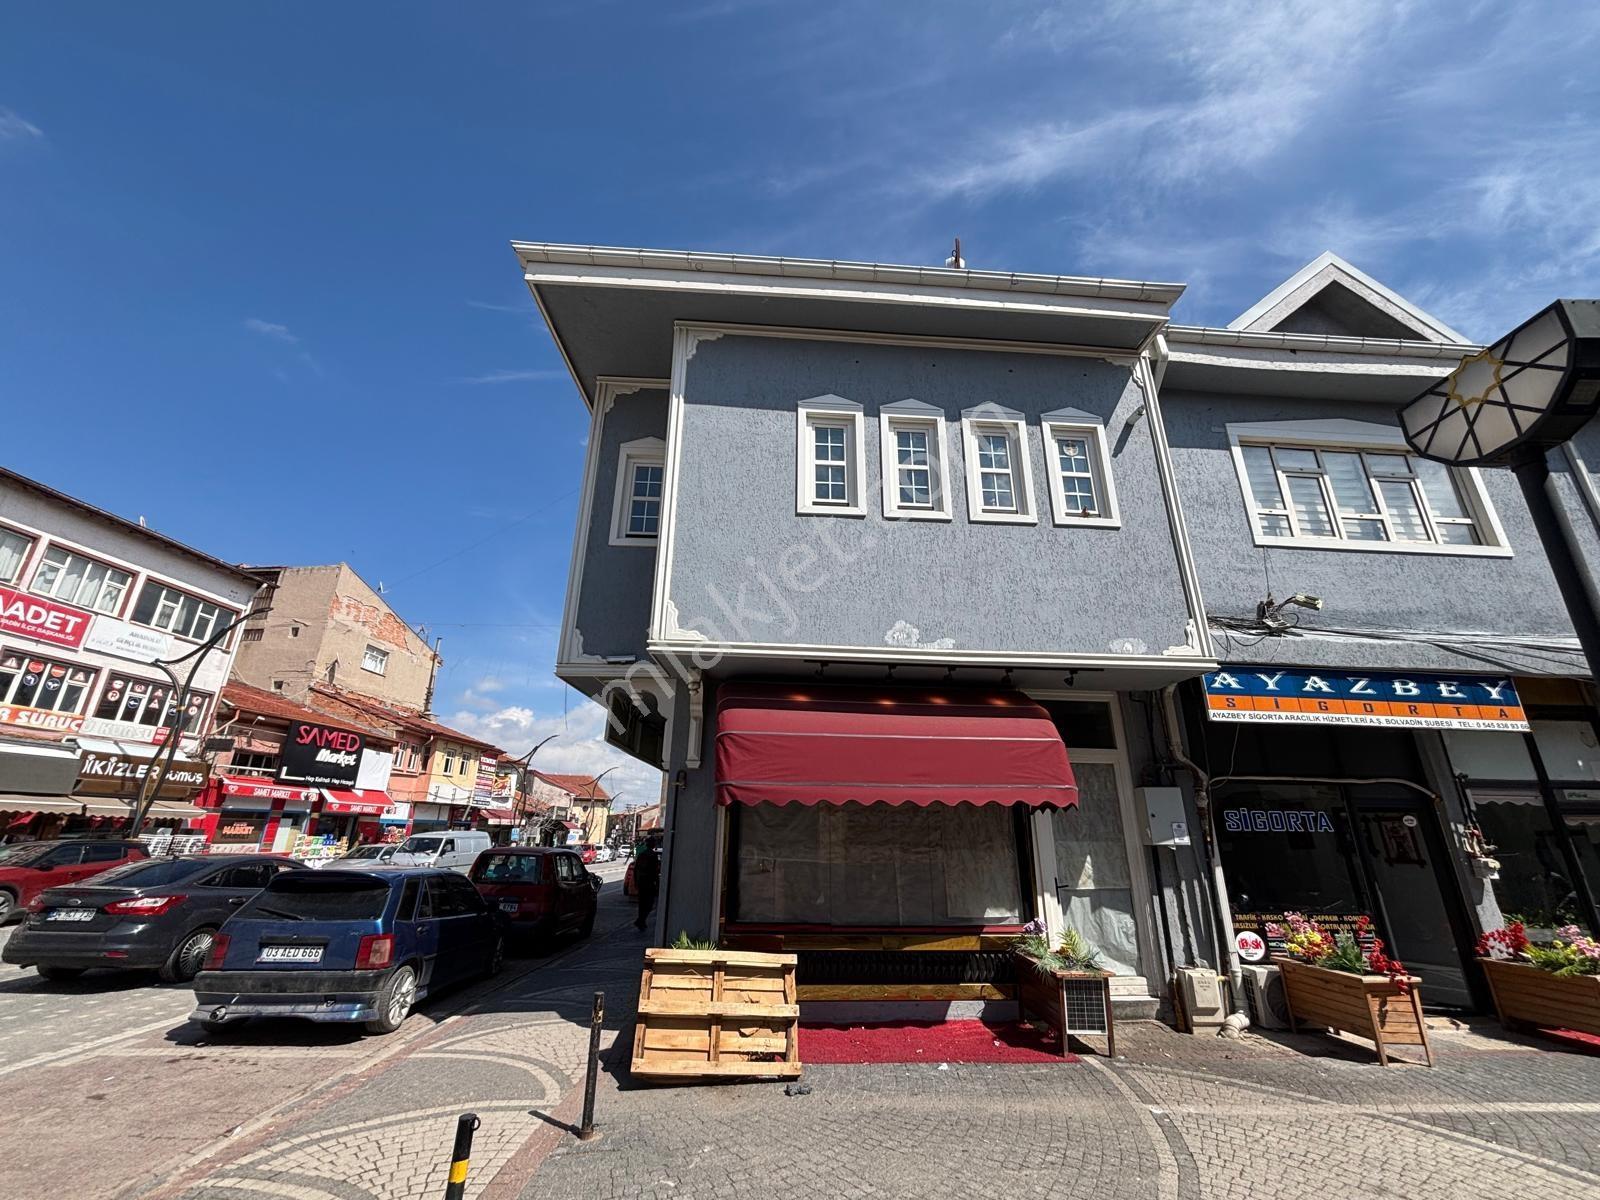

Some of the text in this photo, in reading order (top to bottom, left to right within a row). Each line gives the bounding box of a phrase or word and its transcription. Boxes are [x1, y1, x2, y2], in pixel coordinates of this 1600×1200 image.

[0, 594, 82, 633] ADET
[1210, 670, 1508, 700] AYAZBEY
[1212, 712, 1247, 720] AYAZBEY
[1248, 712, 1284, 721] SİGORTA
[1284, 714, 1321, 722] ARACILIK
[1322, 715, 1368, 724] HİZMETLERİ
[1385, 718, 1423, 726] BOLVADİN
[295, 725, 360, 752] SAMED
[315, 748, 357, 767] Market
[1223, 807, 1335, 832] SİGORTA
[266, 946, 321, 957] 03 AED 666
